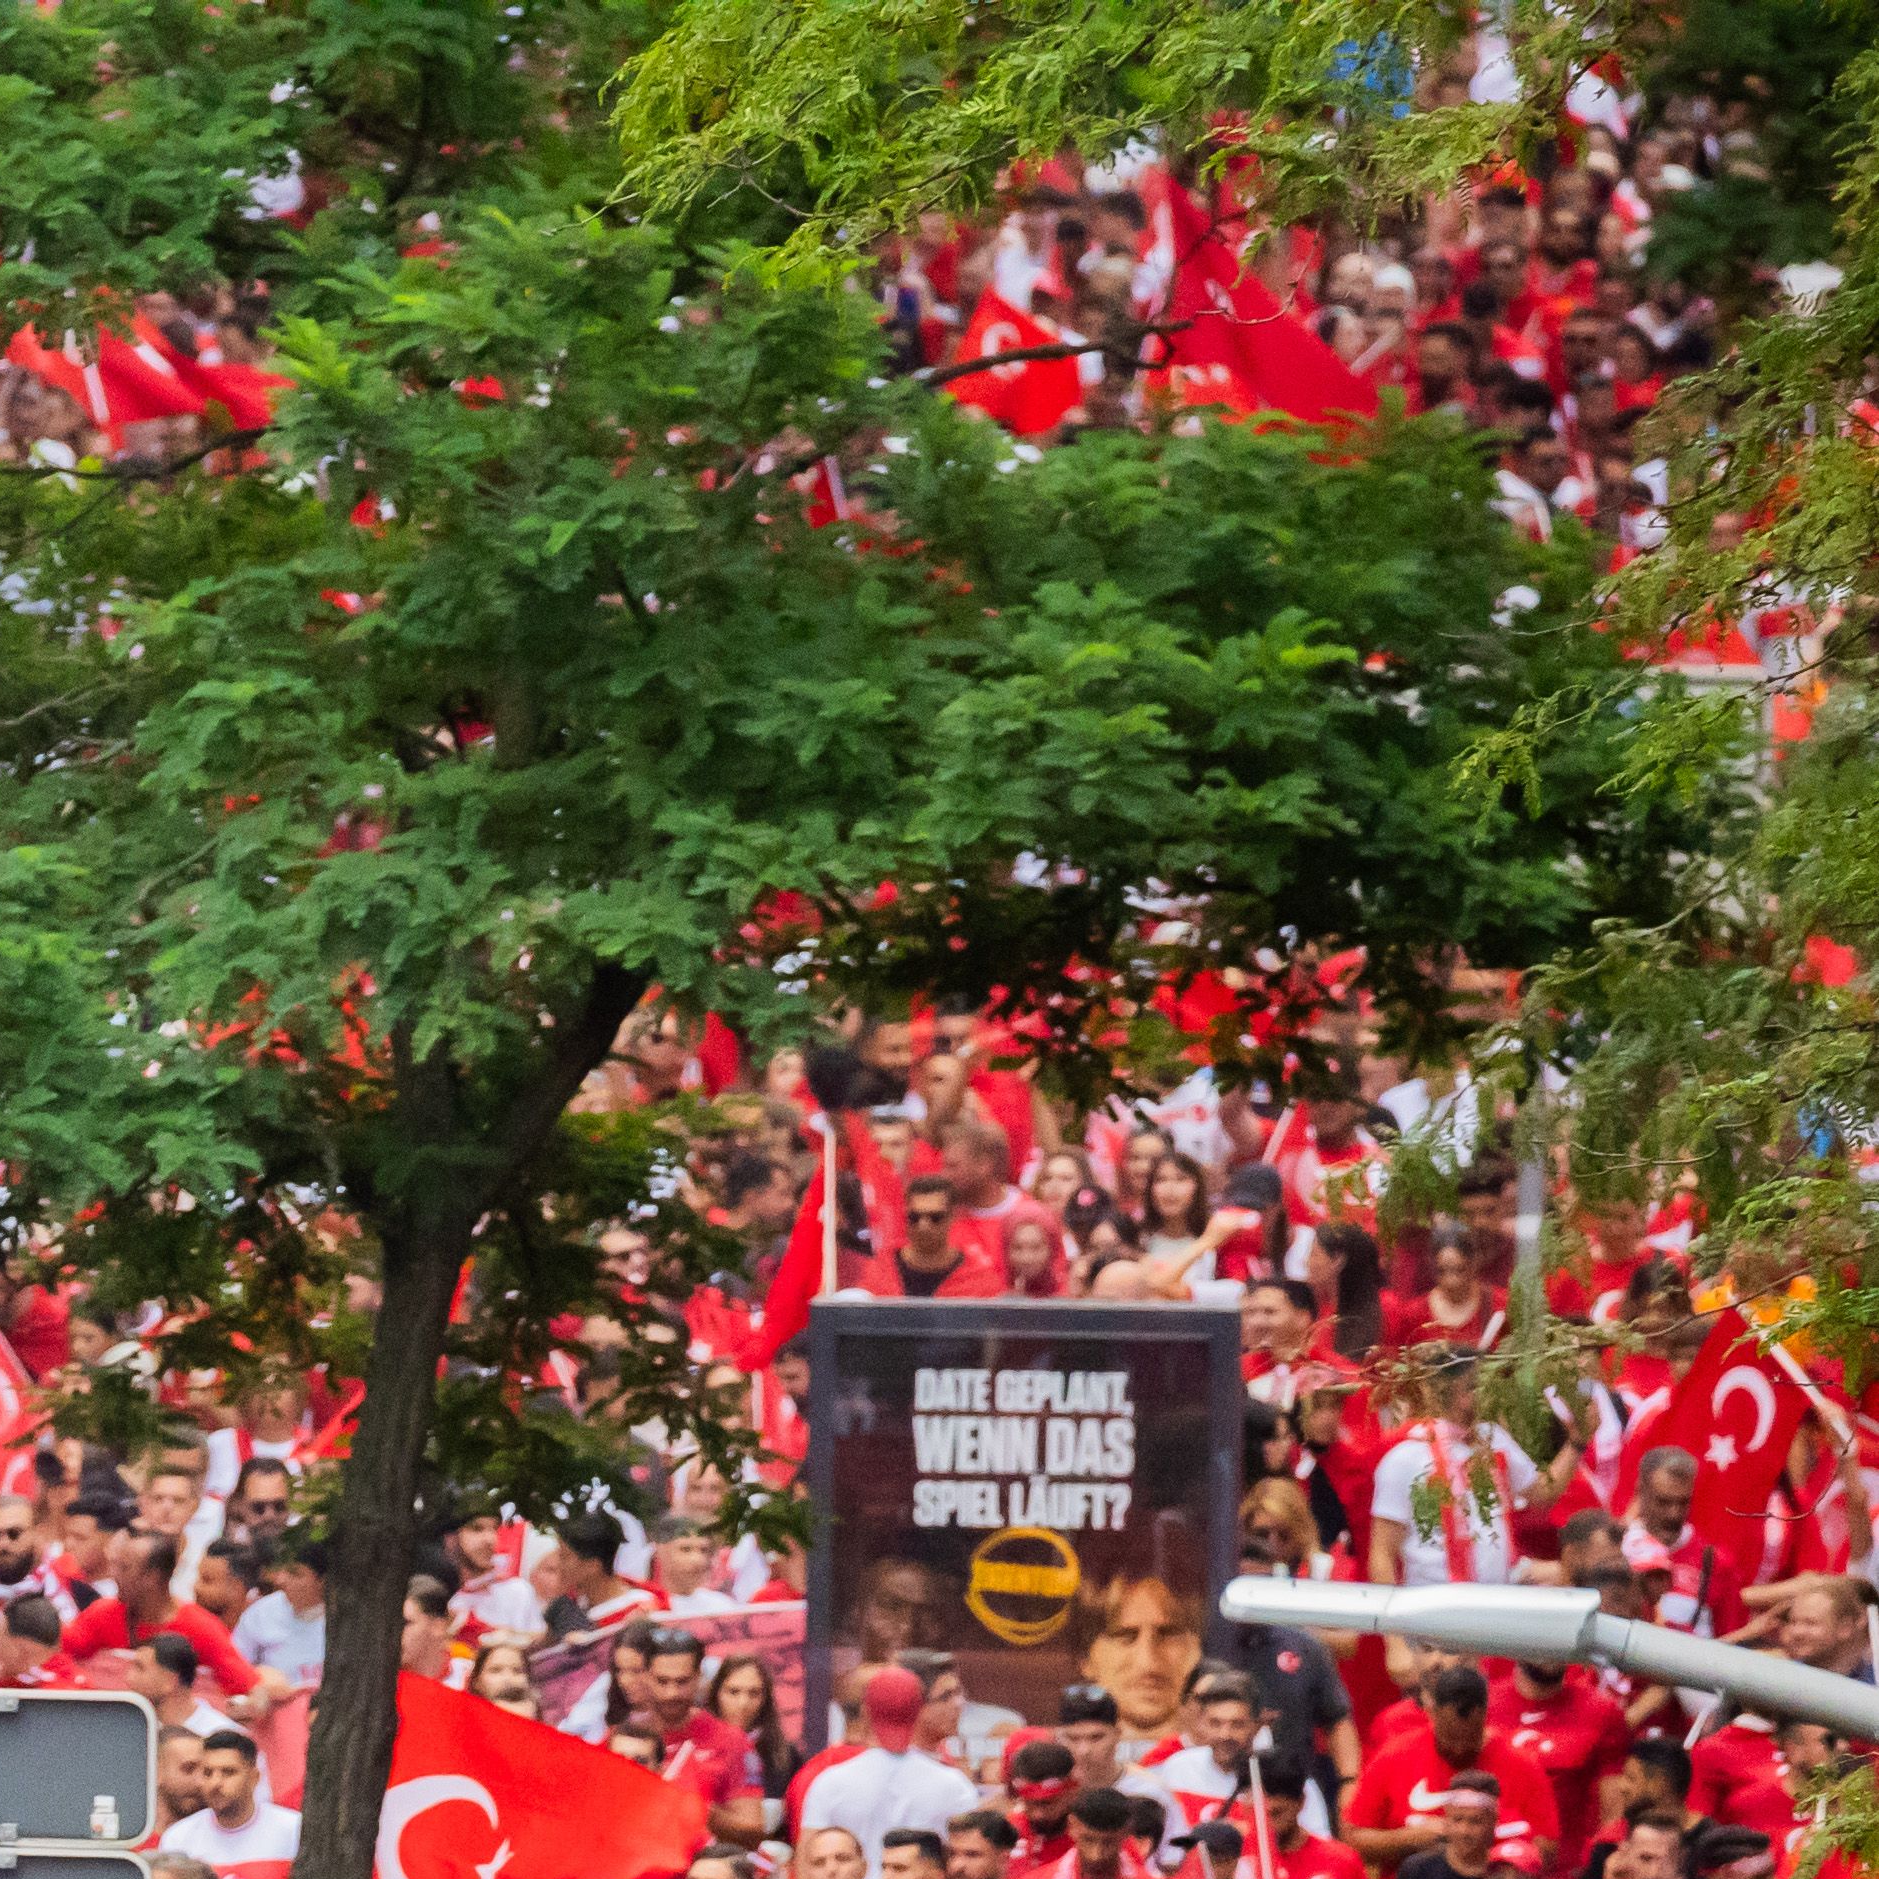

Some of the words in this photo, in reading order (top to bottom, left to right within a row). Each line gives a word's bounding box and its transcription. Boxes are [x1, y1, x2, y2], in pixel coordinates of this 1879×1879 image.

[914, 1367, 992, 1413] DATE
[911, 1413, 1039, 1475] WENN
[1043, 1416, 1137, 1476] DAS
[912, 1478, 1005, 1529] SPIEL
[1007, 1474, 1133, 1532] LÄUFT?
